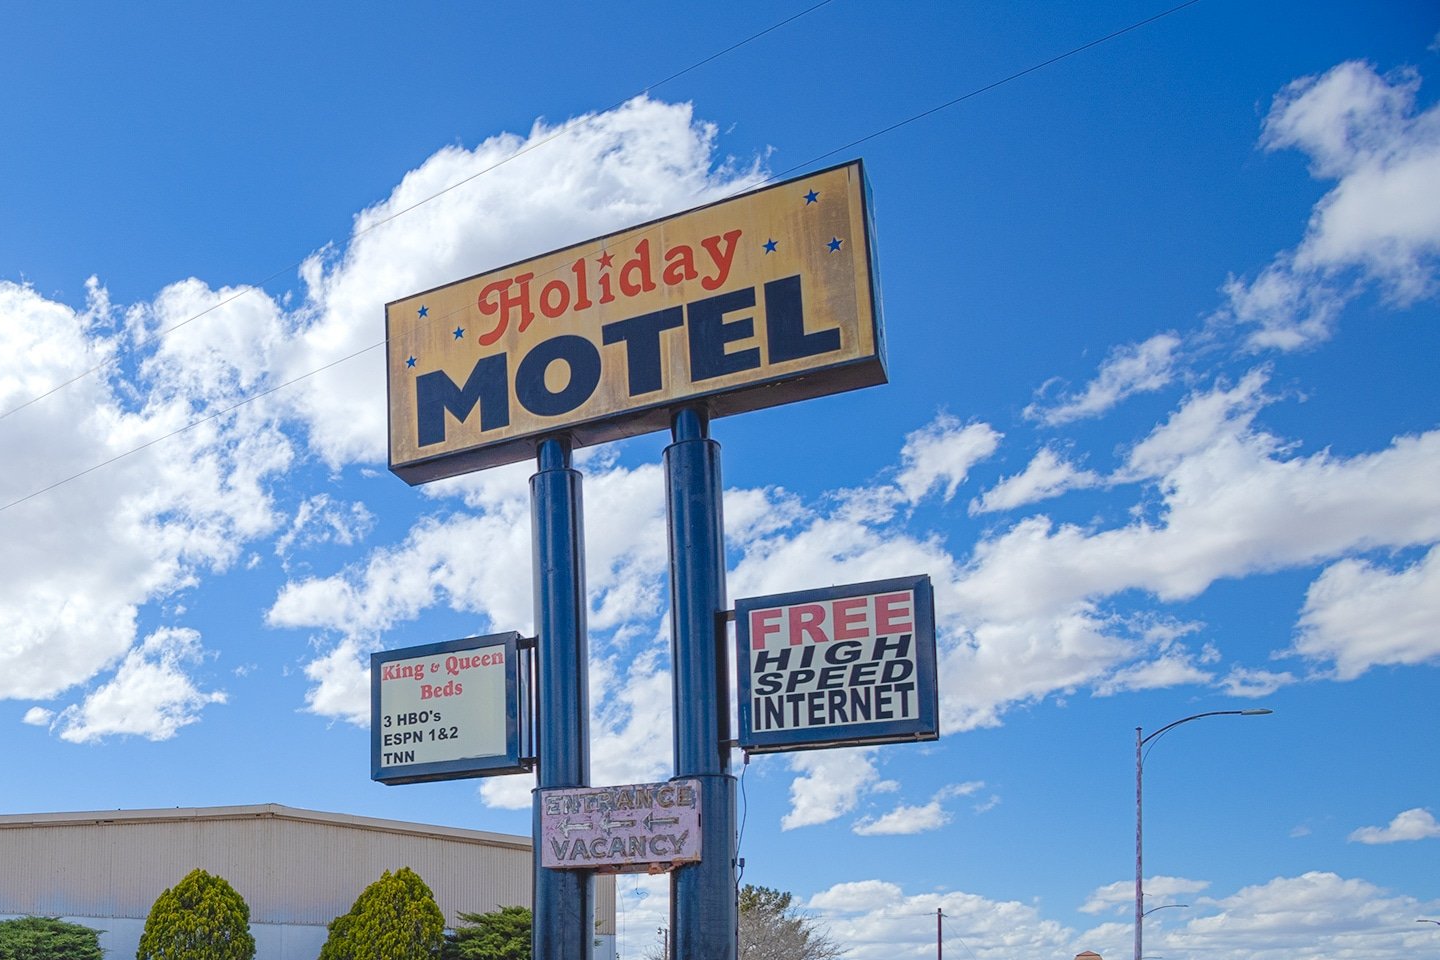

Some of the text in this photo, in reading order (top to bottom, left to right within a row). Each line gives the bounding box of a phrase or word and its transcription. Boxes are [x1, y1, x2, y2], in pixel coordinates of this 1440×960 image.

[478, 229, 743, 346] Holiday
[416, 274, 841, 447] MOTEL
[751, 592, 913, 651] FREE
[382, 651, 504, 681] King & Queen
[754, 634, 912, 673] HIGH
[420, 680, 463, 700] Beds
[754, 659, 914, 696] SPEED
[383, 710, 441, 728] 3 HBO's
[754, 682, 915, 731] INTERNET
[383, 726, 459, 746] ESPN 1&2
[383, 750, 415, 765] TNN
[545, 785, 693, 816] ENTRANCE
[550, 829, 689, 861] VACANCY
